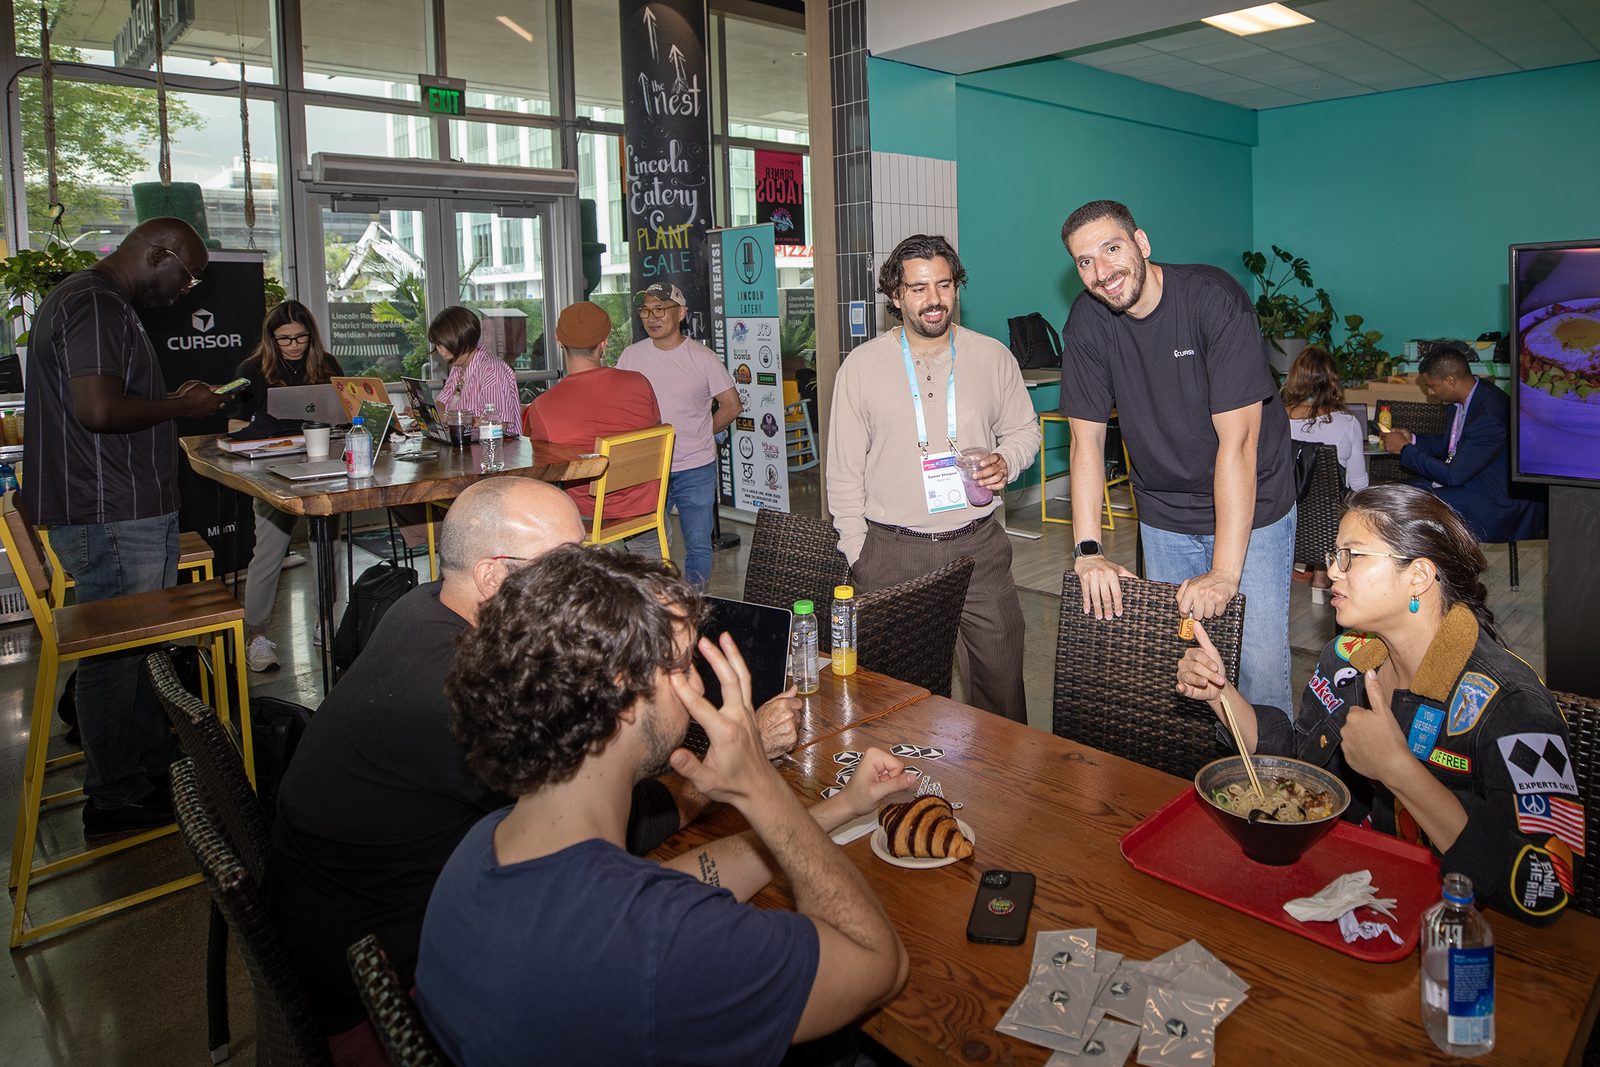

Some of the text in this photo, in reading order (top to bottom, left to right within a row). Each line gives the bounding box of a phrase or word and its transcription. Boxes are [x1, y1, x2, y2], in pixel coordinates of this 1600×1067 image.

[652, 80, 665, 92] the
[654, 74, 701, 117] nest
[429, 88, 460, 114] EXIT
[626, 138, 689, 182] Lincoln
[631, 176, 698, 235] Eatery
[637, 224, 694, 252] PLANT
[642, 251, 691, 277] SALE
[711, 243, 722, 300] TREATS!
[737, 290, 764, 301] LINCOLN
[331, 312, 359, 320] Lincoln
[714, 304, 724, 315] &
[740, 304, 762, 315] EATERY
[167, 334, 242, 350] CURSOR
[1309, 662, 1345, 714] oked
[1424, 711, 1435, 722] YOU
[1441, 753, 1468, 770] FREE
[1518, 781, 1575, 791] EXPERTS ONLY
[1523, 853, 1543, 908] THE RIDE
